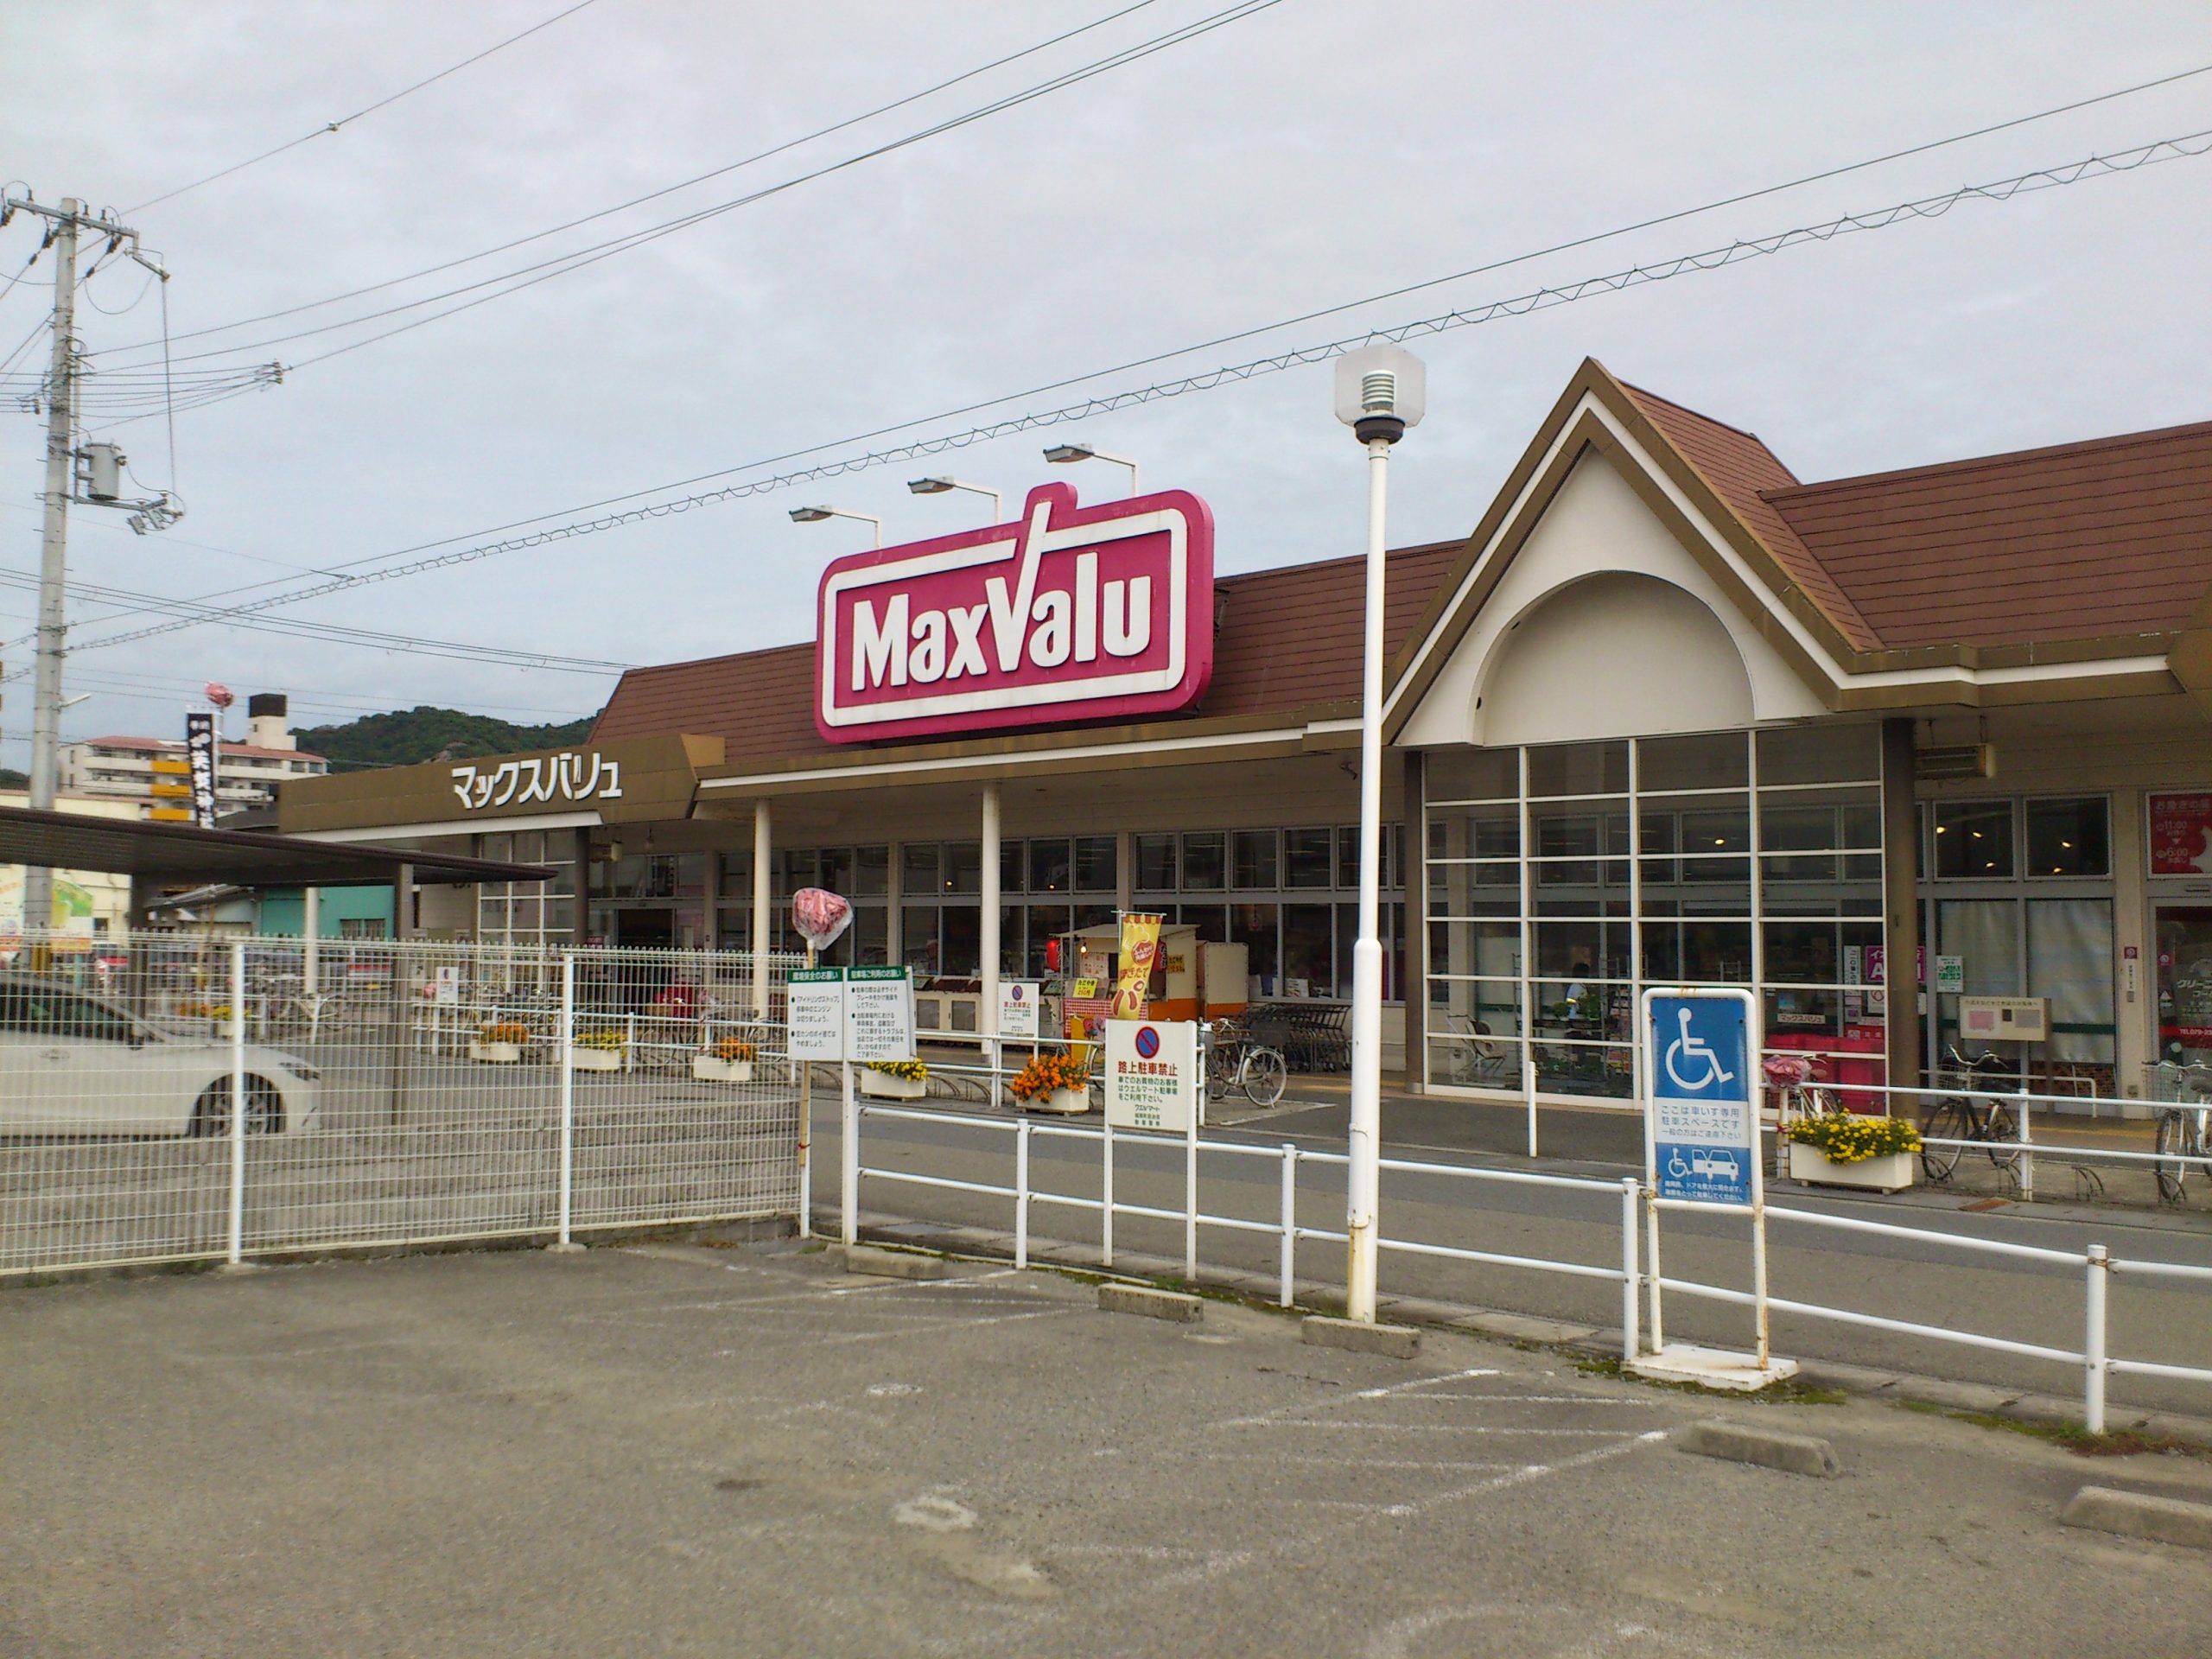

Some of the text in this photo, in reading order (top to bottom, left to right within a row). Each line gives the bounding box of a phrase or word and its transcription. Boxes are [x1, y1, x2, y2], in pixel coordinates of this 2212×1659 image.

[851, 501, 1152, 692] MaxValu
[452, 752, 623, 810] マックスバリュ
[1118, 1060, 1179, 1077] 路上駐車禁止
[1662, 1106, 1739, 1118] ここは車いす専用
[1662, 1116, 1740, 1128] 駐車スペースです
